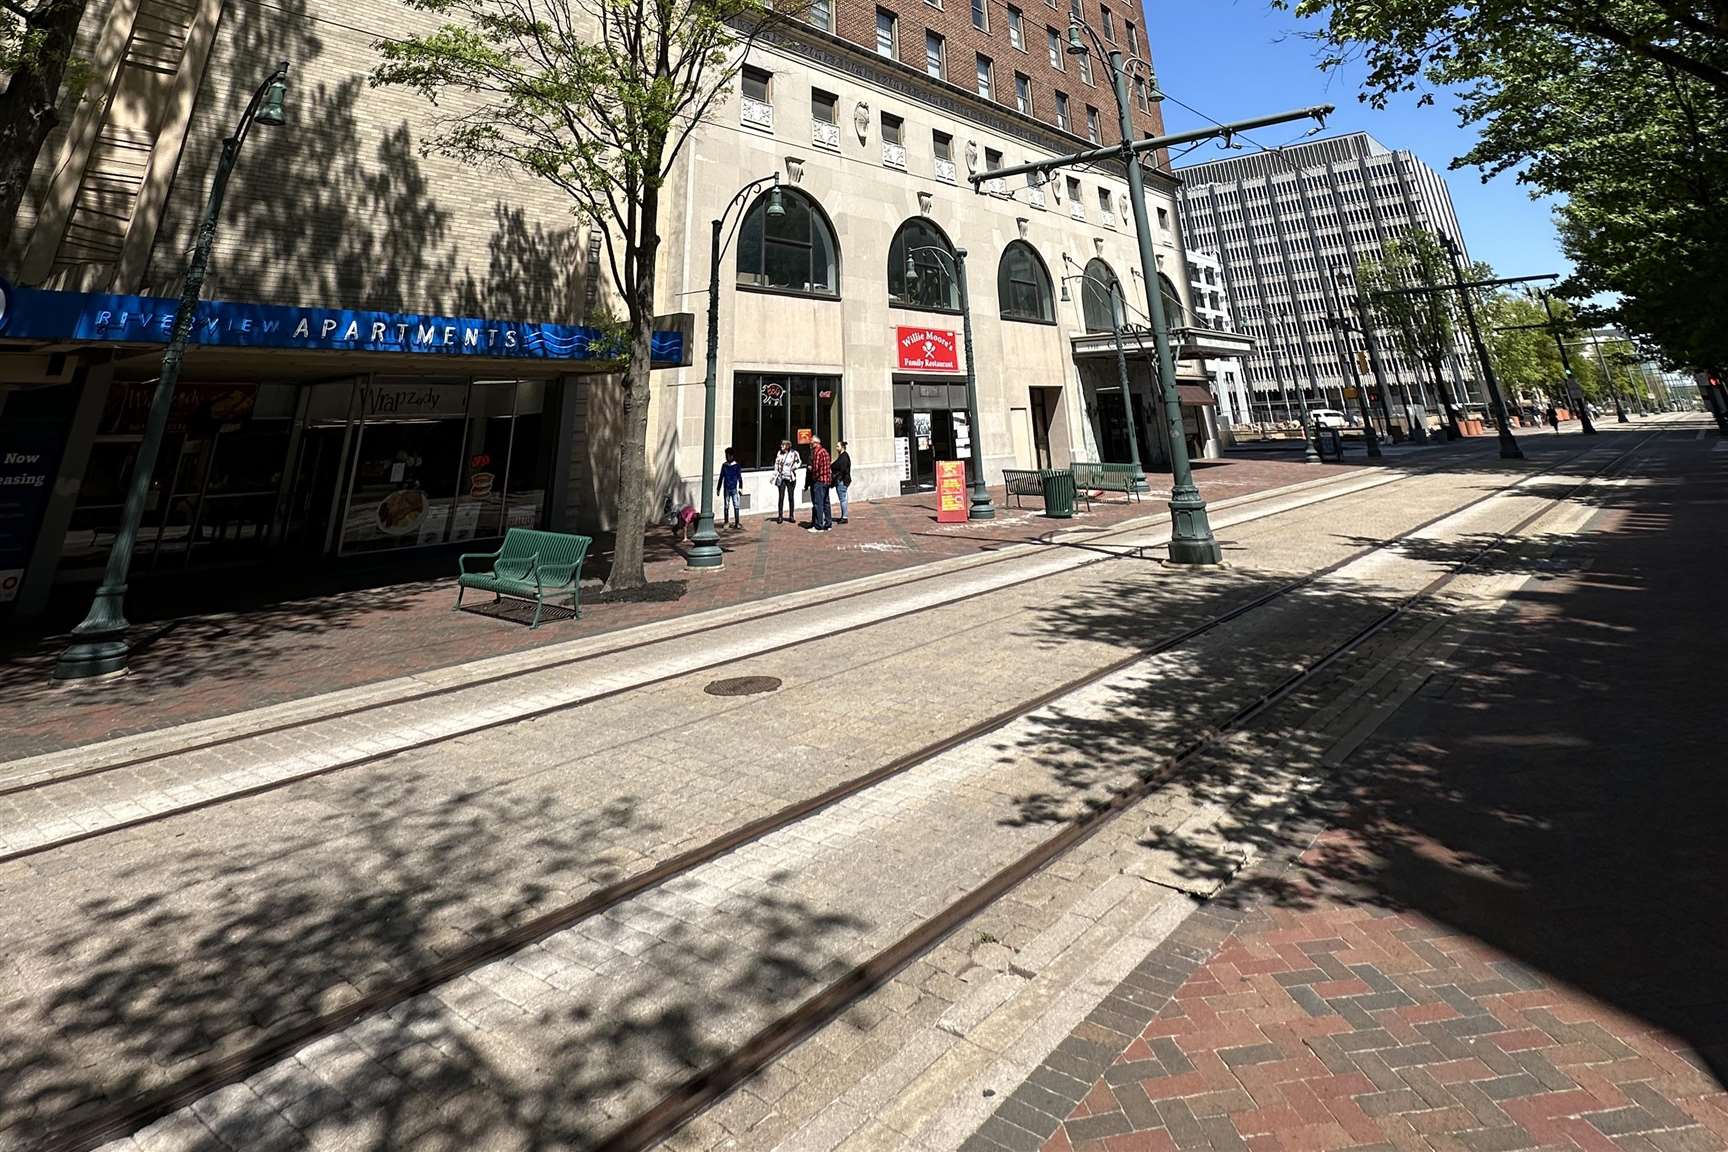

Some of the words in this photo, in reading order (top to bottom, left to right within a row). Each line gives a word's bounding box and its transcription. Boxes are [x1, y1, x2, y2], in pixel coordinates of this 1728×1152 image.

[292, 317, 519, 348] APARTMENTS
[902, 332, 925, 348] Willie
[925, 331, 953, 352] Moore's
[904, 358, 924, 369] Family
[924, 359, 954, 369] Restaurant
[3, 452, 42, 465] Now
